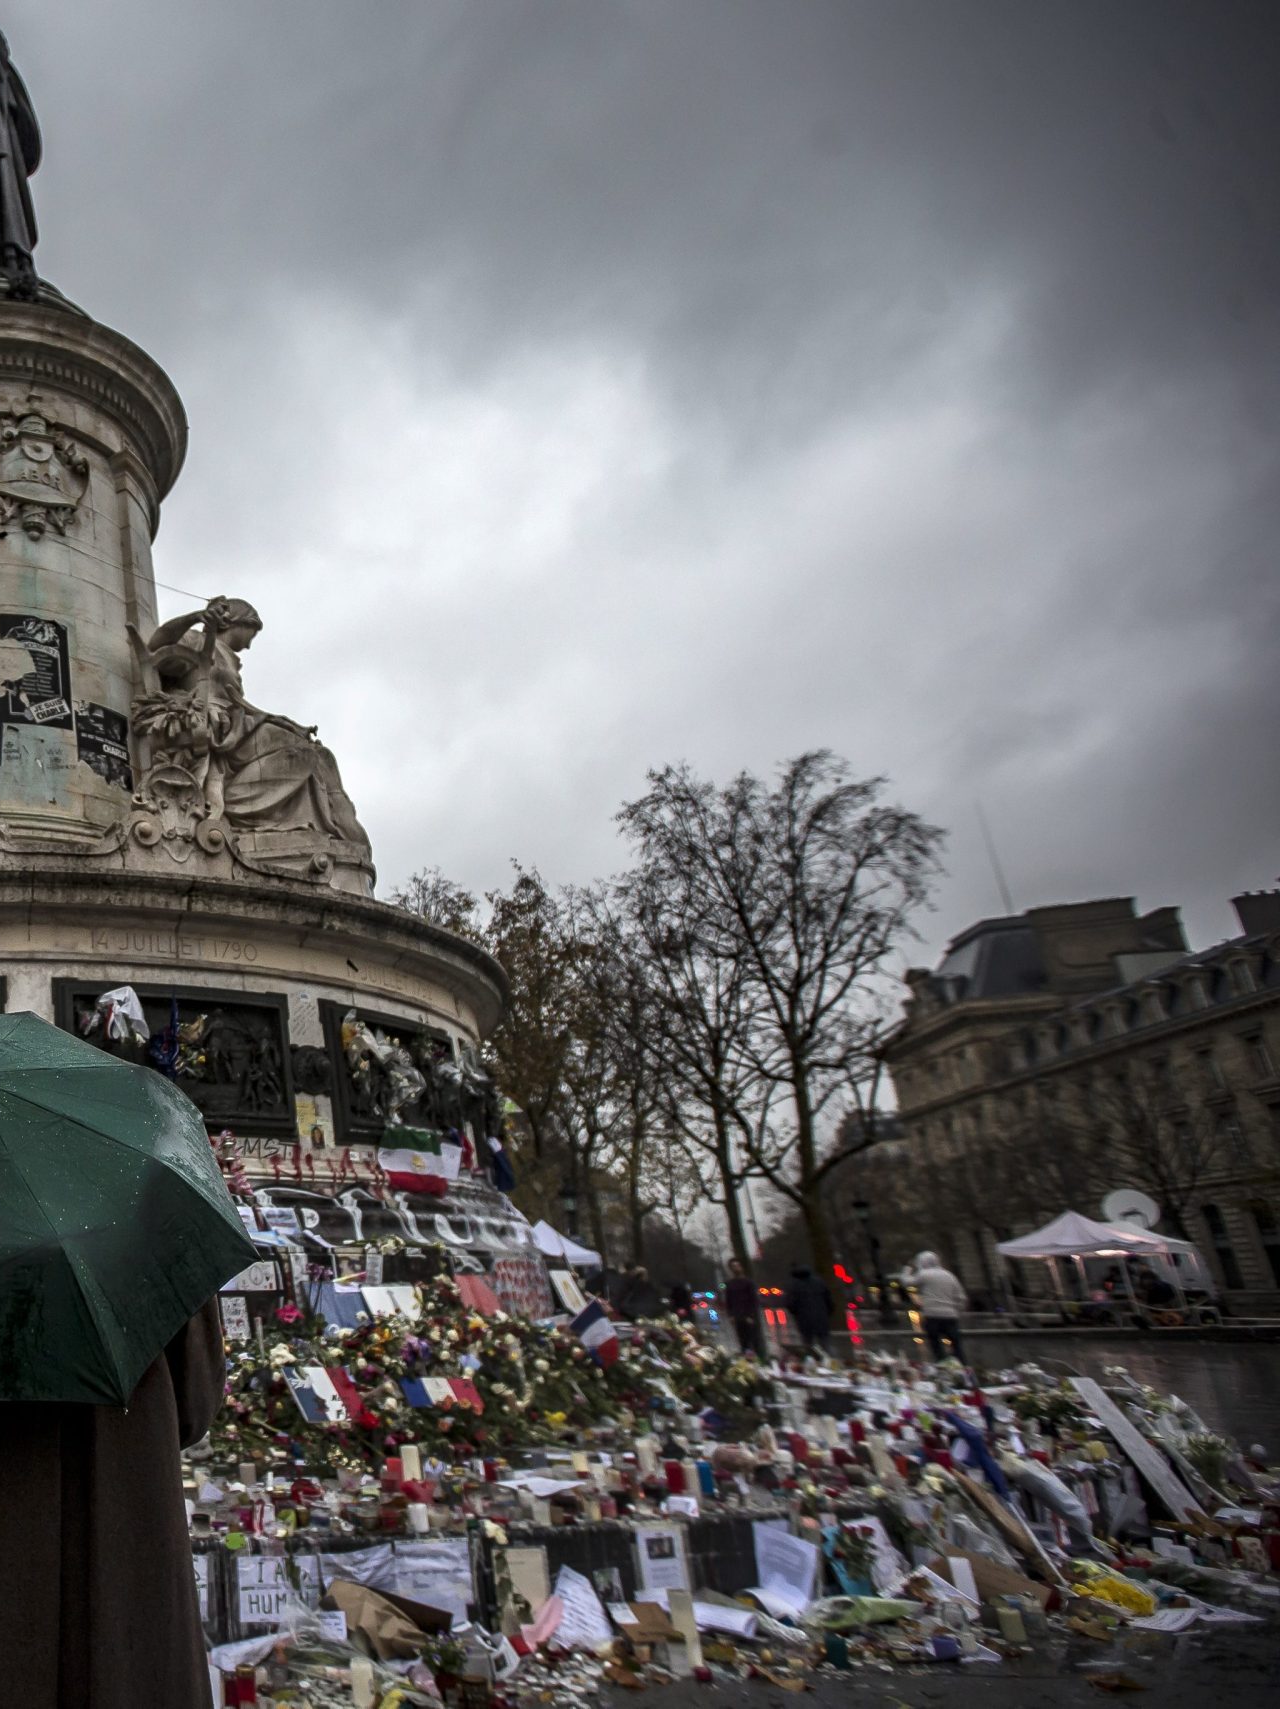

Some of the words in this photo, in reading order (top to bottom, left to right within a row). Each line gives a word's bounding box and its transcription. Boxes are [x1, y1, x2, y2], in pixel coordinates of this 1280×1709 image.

[33, 704, 44, 713] JE
[43, 699, 63, 710] SUIS
[36, 706, 67, 720] CHARLIE
[90, 930, 109, 950] 14
[119, 932, 206, 957] JUILLET
[213, 940, 258, 962] 1790
[257, 1561, 264, 1583] I
[248, 1593, 310, 1614] HUMN
